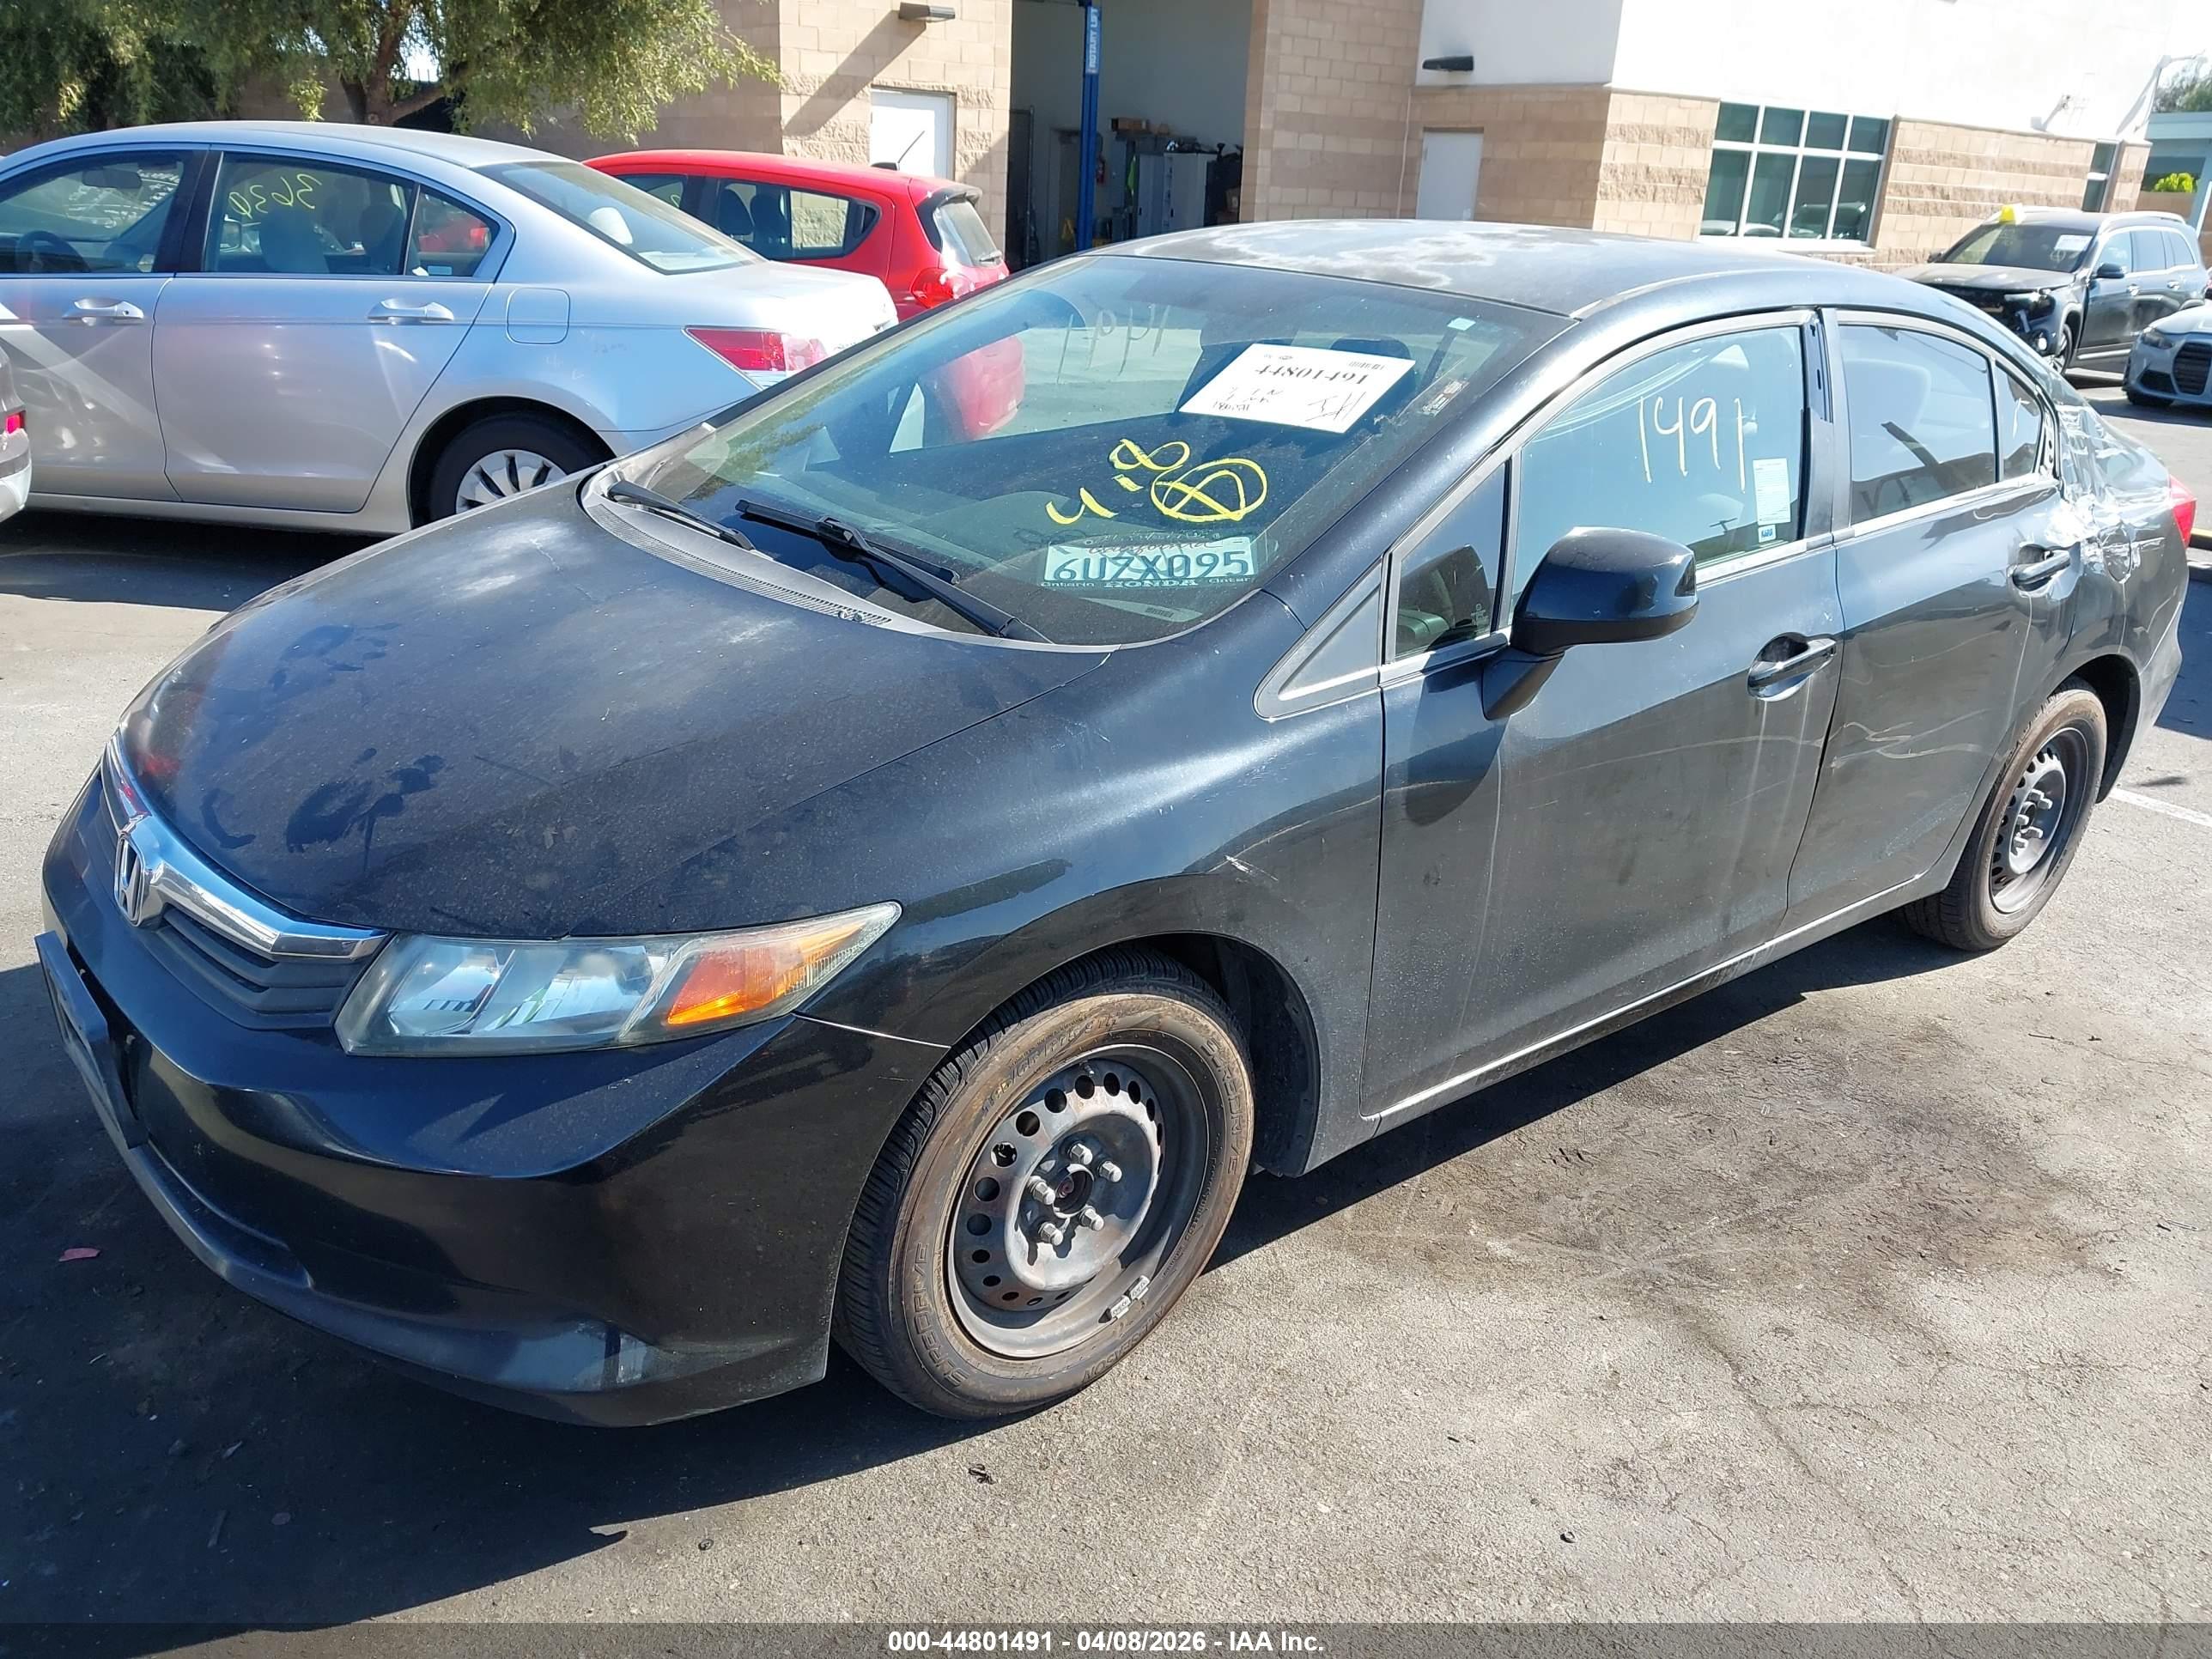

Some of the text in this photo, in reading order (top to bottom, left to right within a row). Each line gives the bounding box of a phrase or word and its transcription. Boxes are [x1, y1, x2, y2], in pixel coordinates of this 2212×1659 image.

[1089, 7, 1099, 68] ROTARY LIFT
[1255, 364, 1370, 385] 44801491
[1638, 396, 1747, 495] 1491
[1053, 550, 1250, 581] 6UZX095
[1103, 580, 1199, 589] HONDA
[912, 1242, 970, 1388] SUREDRIVE
